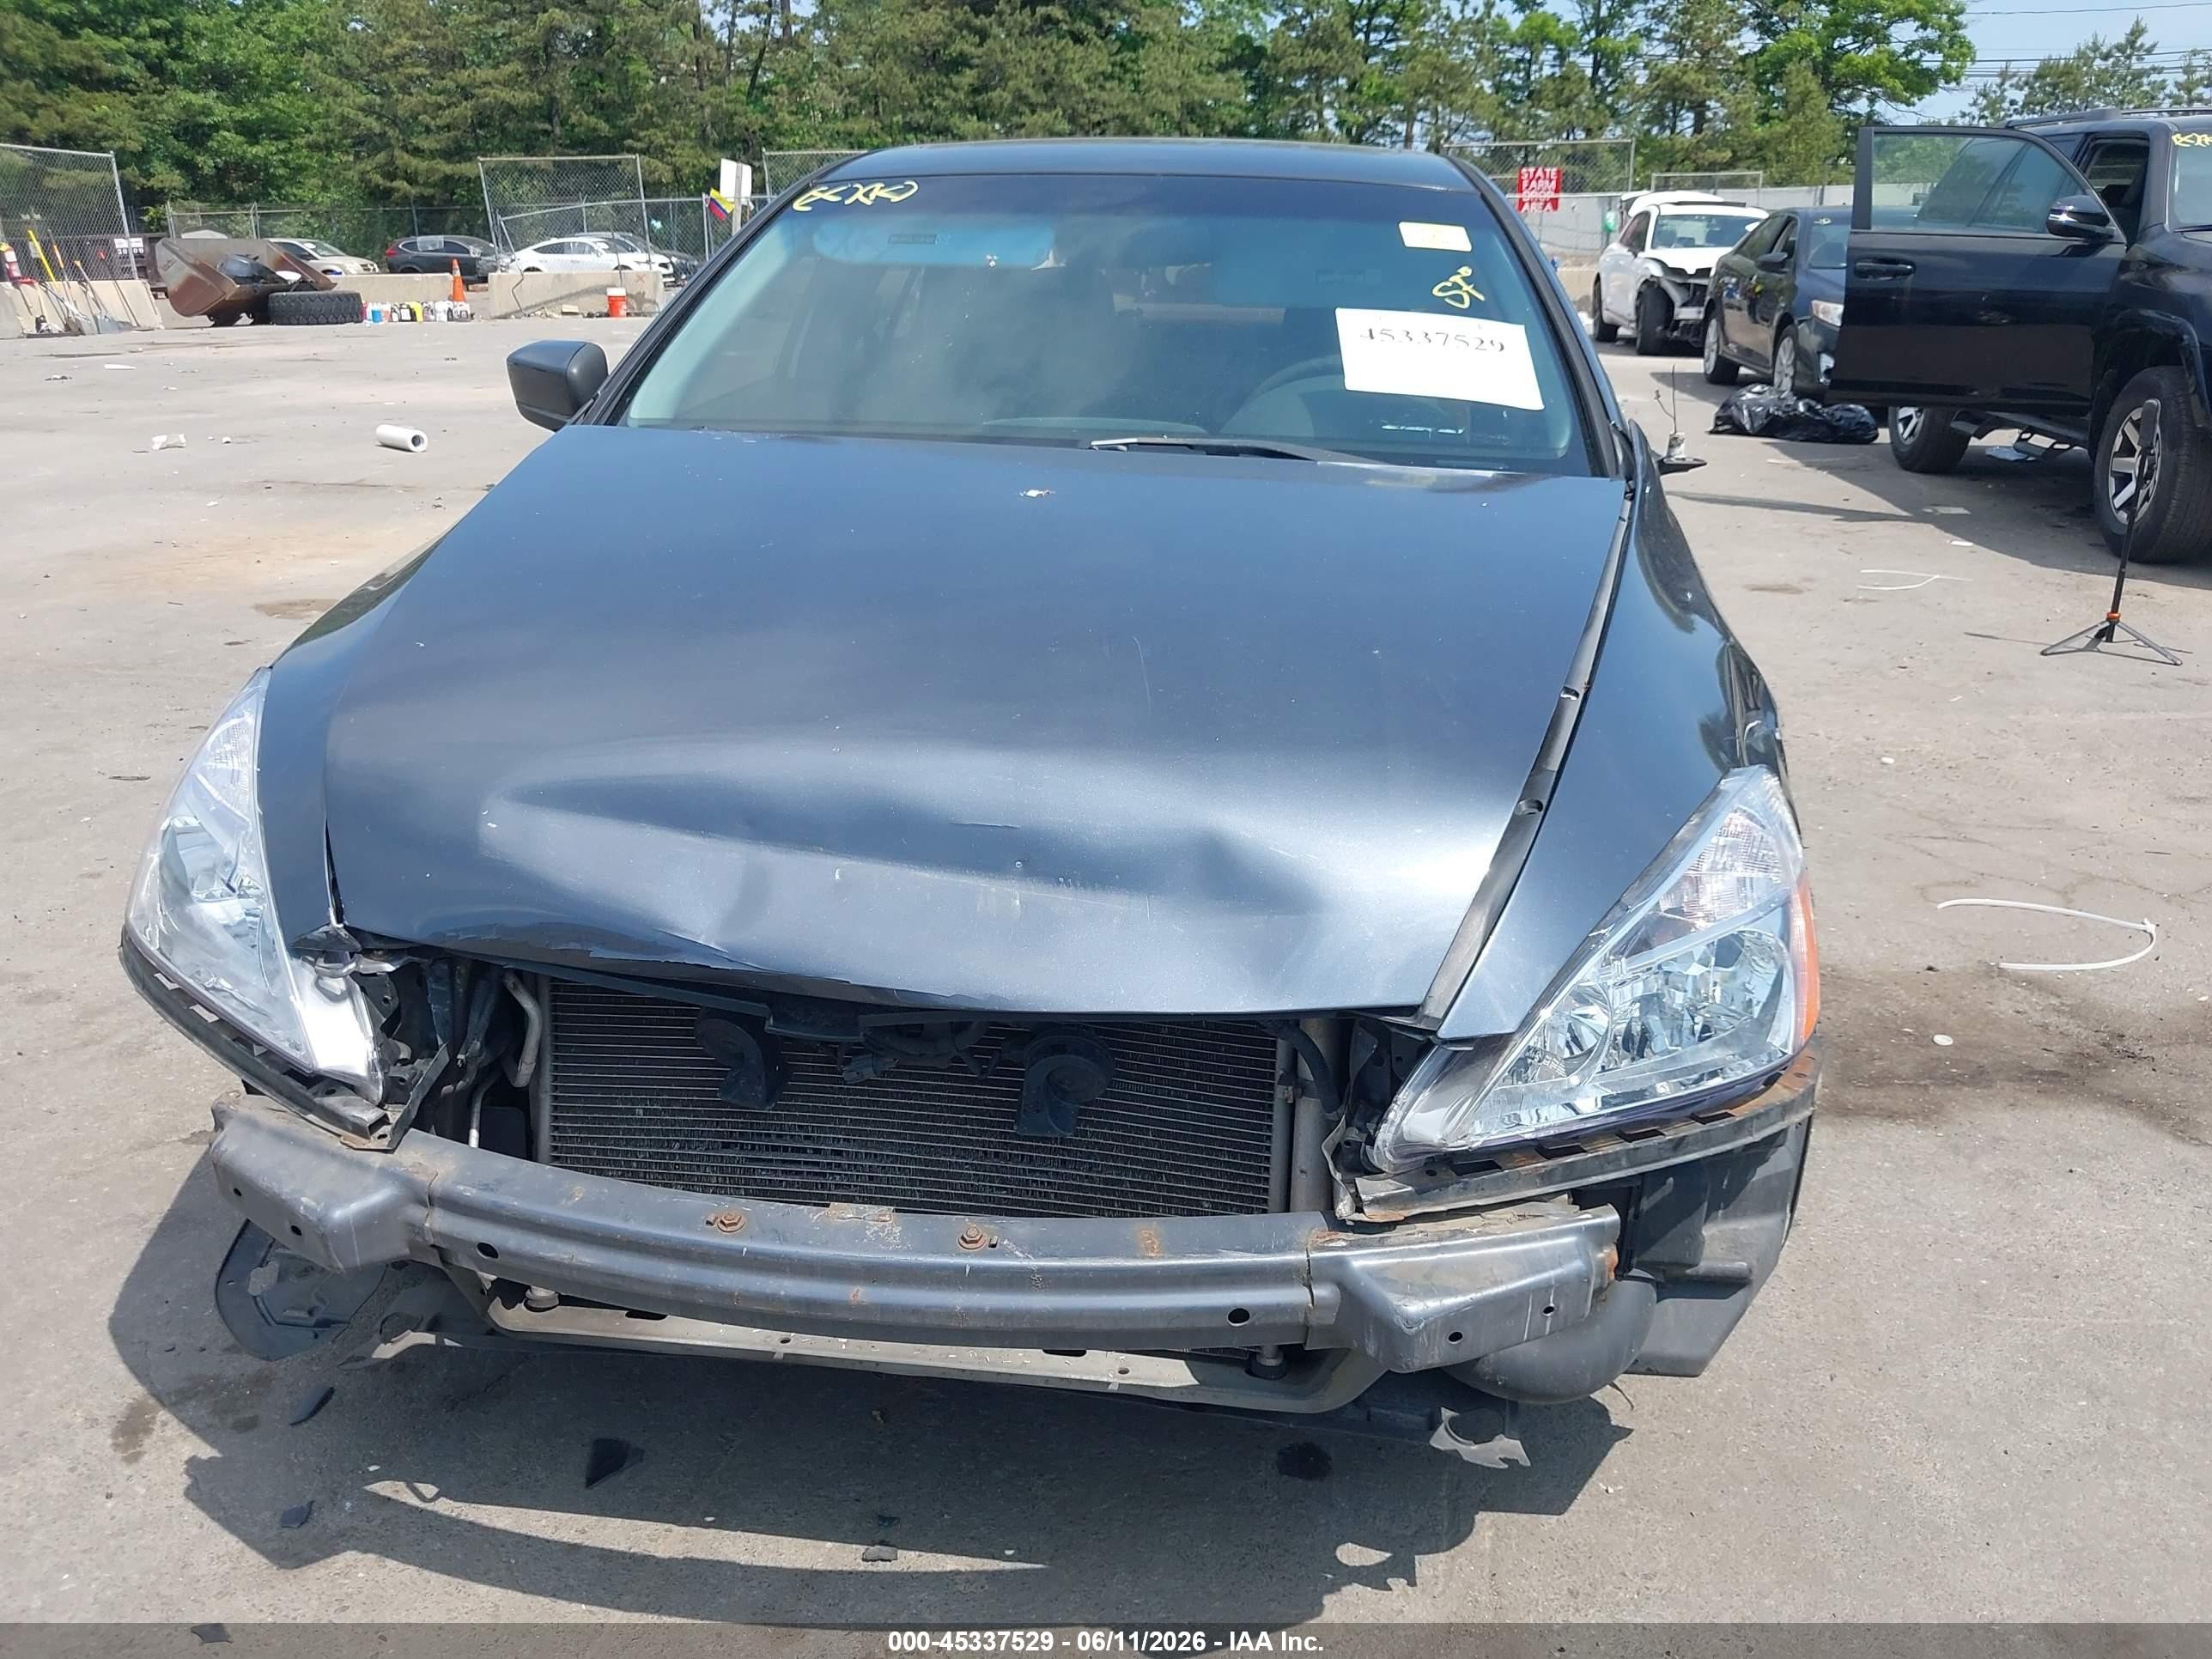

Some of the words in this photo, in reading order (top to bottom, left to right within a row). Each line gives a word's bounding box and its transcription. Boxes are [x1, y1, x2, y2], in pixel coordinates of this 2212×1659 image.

[1521, 167, 1558, 179] STATE
[1522, 179, 1556, 191] FARM
[1521, 201, 1555, 213] AREA
